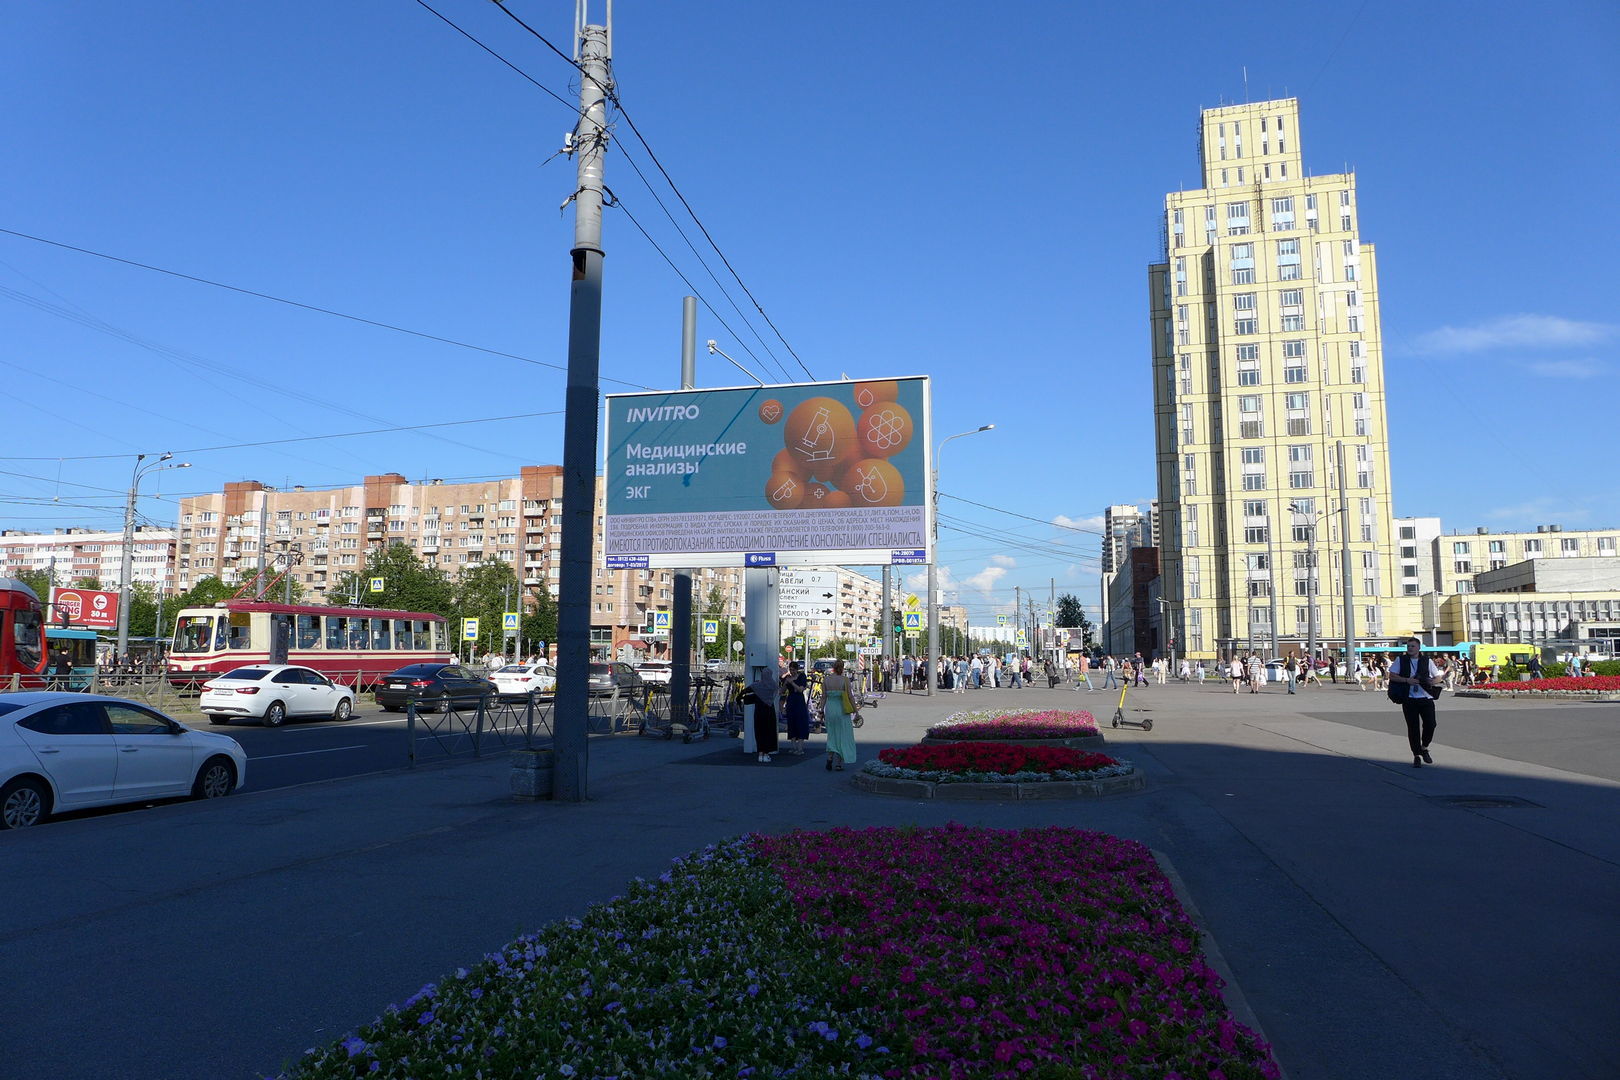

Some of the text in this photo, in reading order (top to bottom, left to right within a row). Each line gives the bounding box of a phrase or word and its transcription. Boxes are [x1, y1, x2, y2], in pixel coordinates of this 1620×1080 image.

[626, 405, 700, 422] INVITRO
[626, 442, 746, 460] Медицинские
[626, 462, 699, 476] анализы
[626, 486, 651, 499] ЭКГ
[609, 531, 922, 552] ИМЕЮТСЯ ПРОТИВОПОКАЗАНИЯ. НЕОБХОДИМО ПОЛУЧЕНИЕ КОНСУЛЬТАЦИИ СПЕЦИАЛИСТА.
